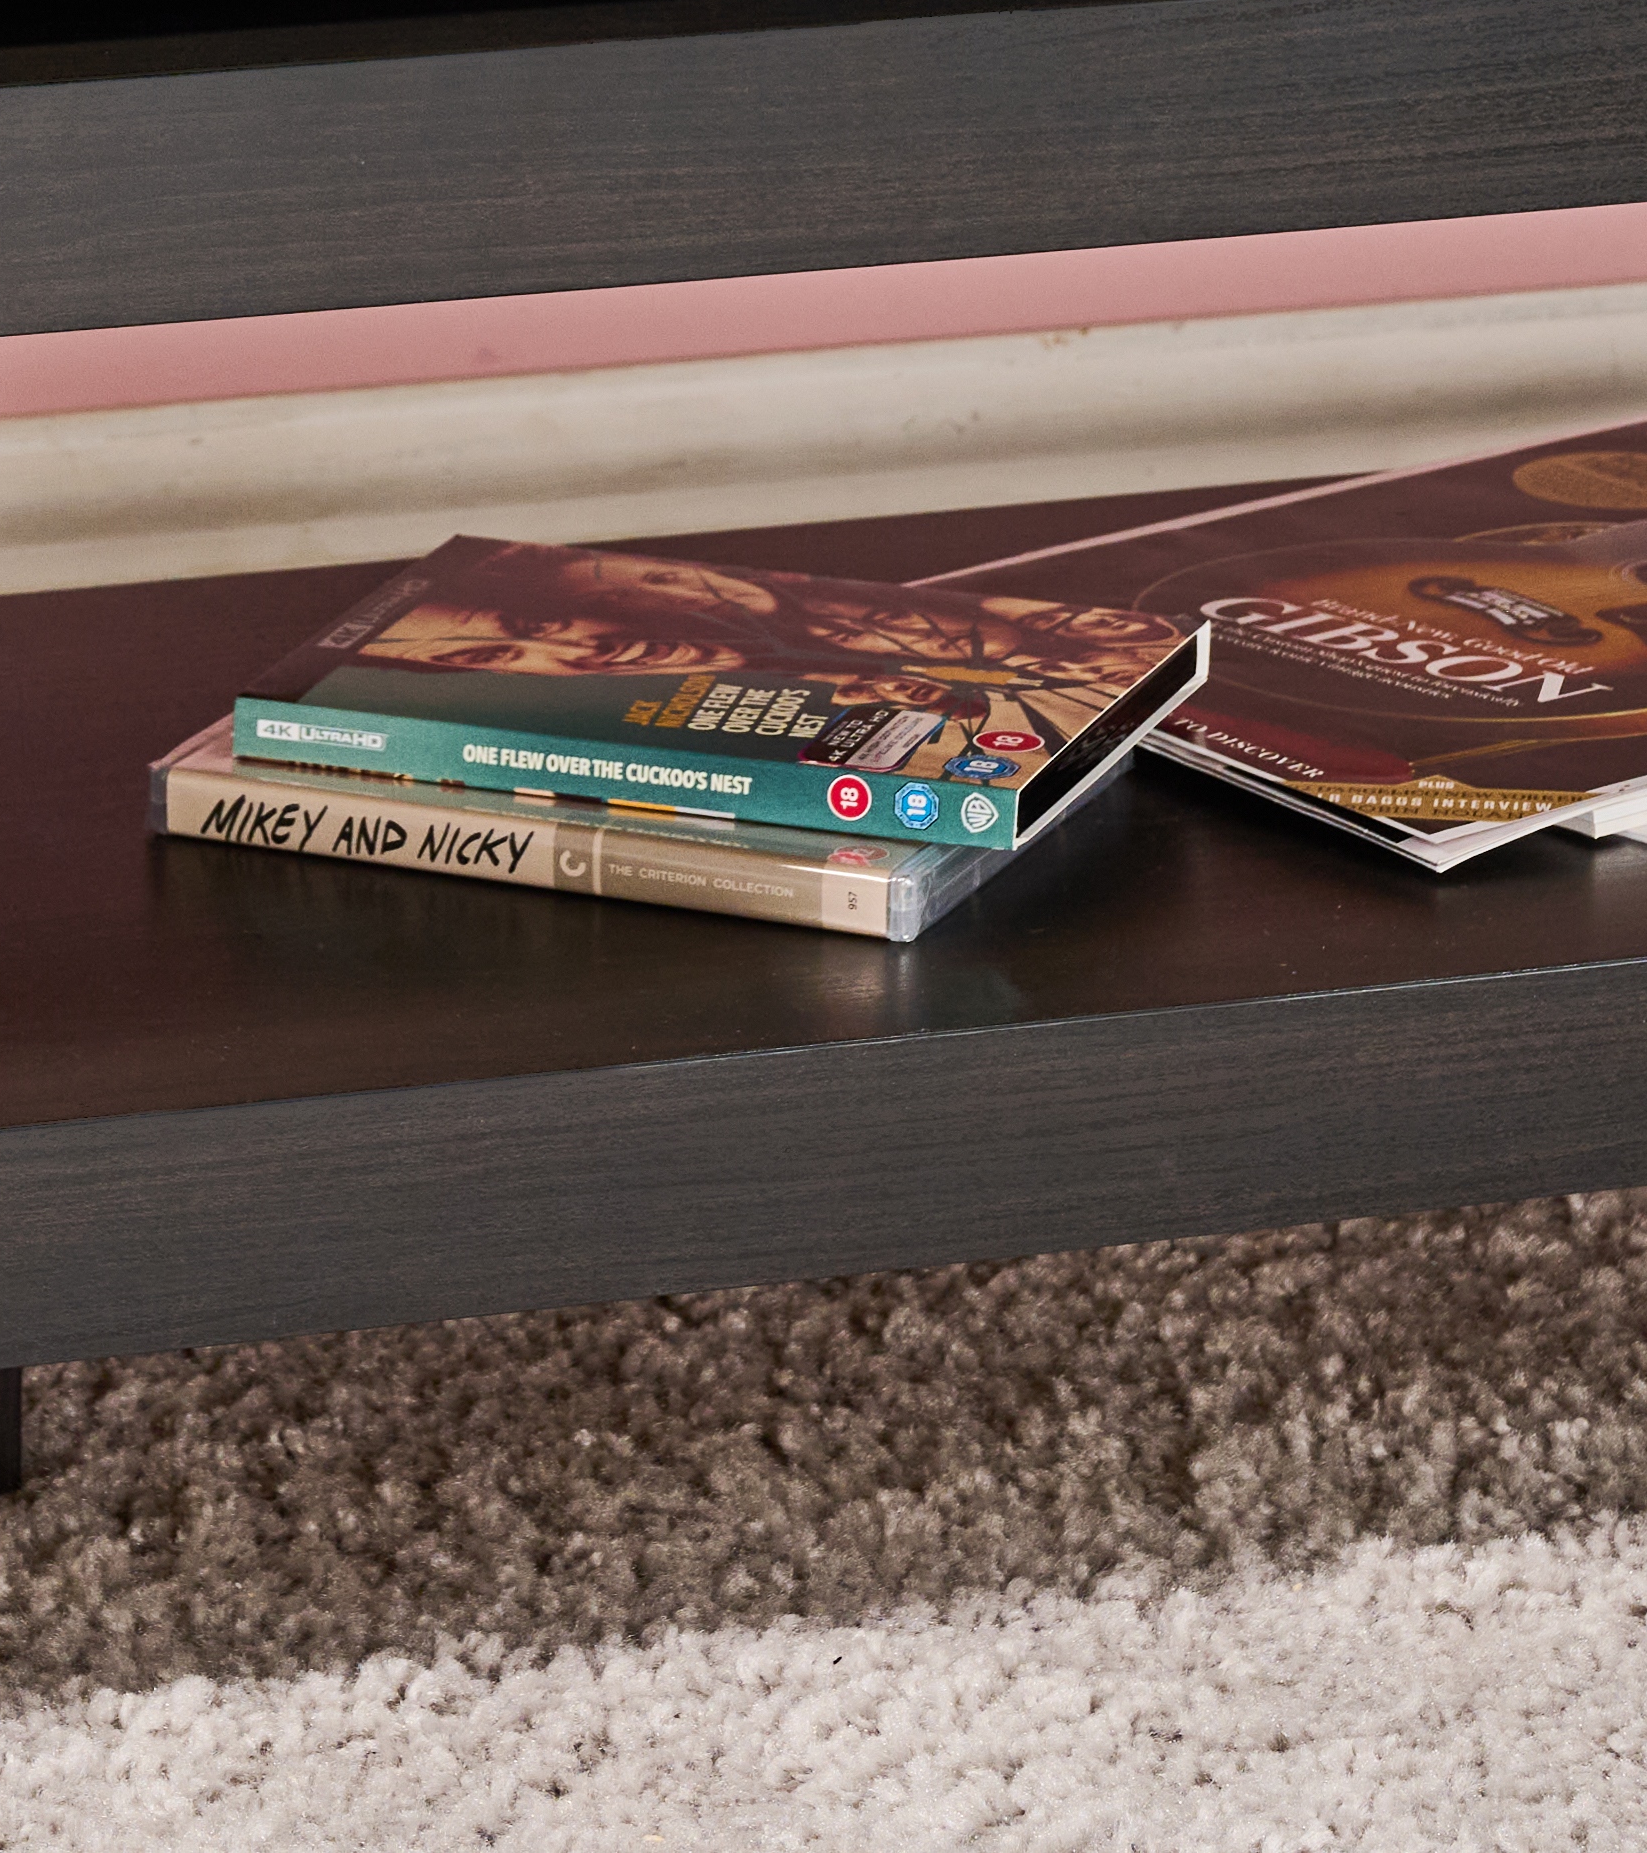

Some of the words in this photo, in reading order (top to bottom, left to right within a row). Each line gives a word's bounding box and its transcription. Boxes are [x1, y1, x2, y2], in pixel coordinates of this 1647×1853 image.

[1199, 596, 1614, 703] GIBSON
[262, 721, 295, 740] 4K
[463, 744, 497, 764] ONE
[501, 748, 542, 770] FLEW
[546, 752, 587, 775] OVER
[588, 757, 622, 780] THE
[626, 761, 707, 791] CUCKOO'S
[710, 773, 752, 796] NEST
[840, 787, 858, 810] 18
[907, 794, 927, 816] 18
[1433, 797, 1552, 812] INTERVIEW
[200, 795, 327, 845] MIKEY
[333, 815, 408, 856] AND
[418, 822, 534, 873] NICKY
[608, 863, 633, 879] THE
[637, 867, 706, 887] CRITERION
[713, 879, 795, 899] COLLECTION
[847, 891, 858, 911] 957
